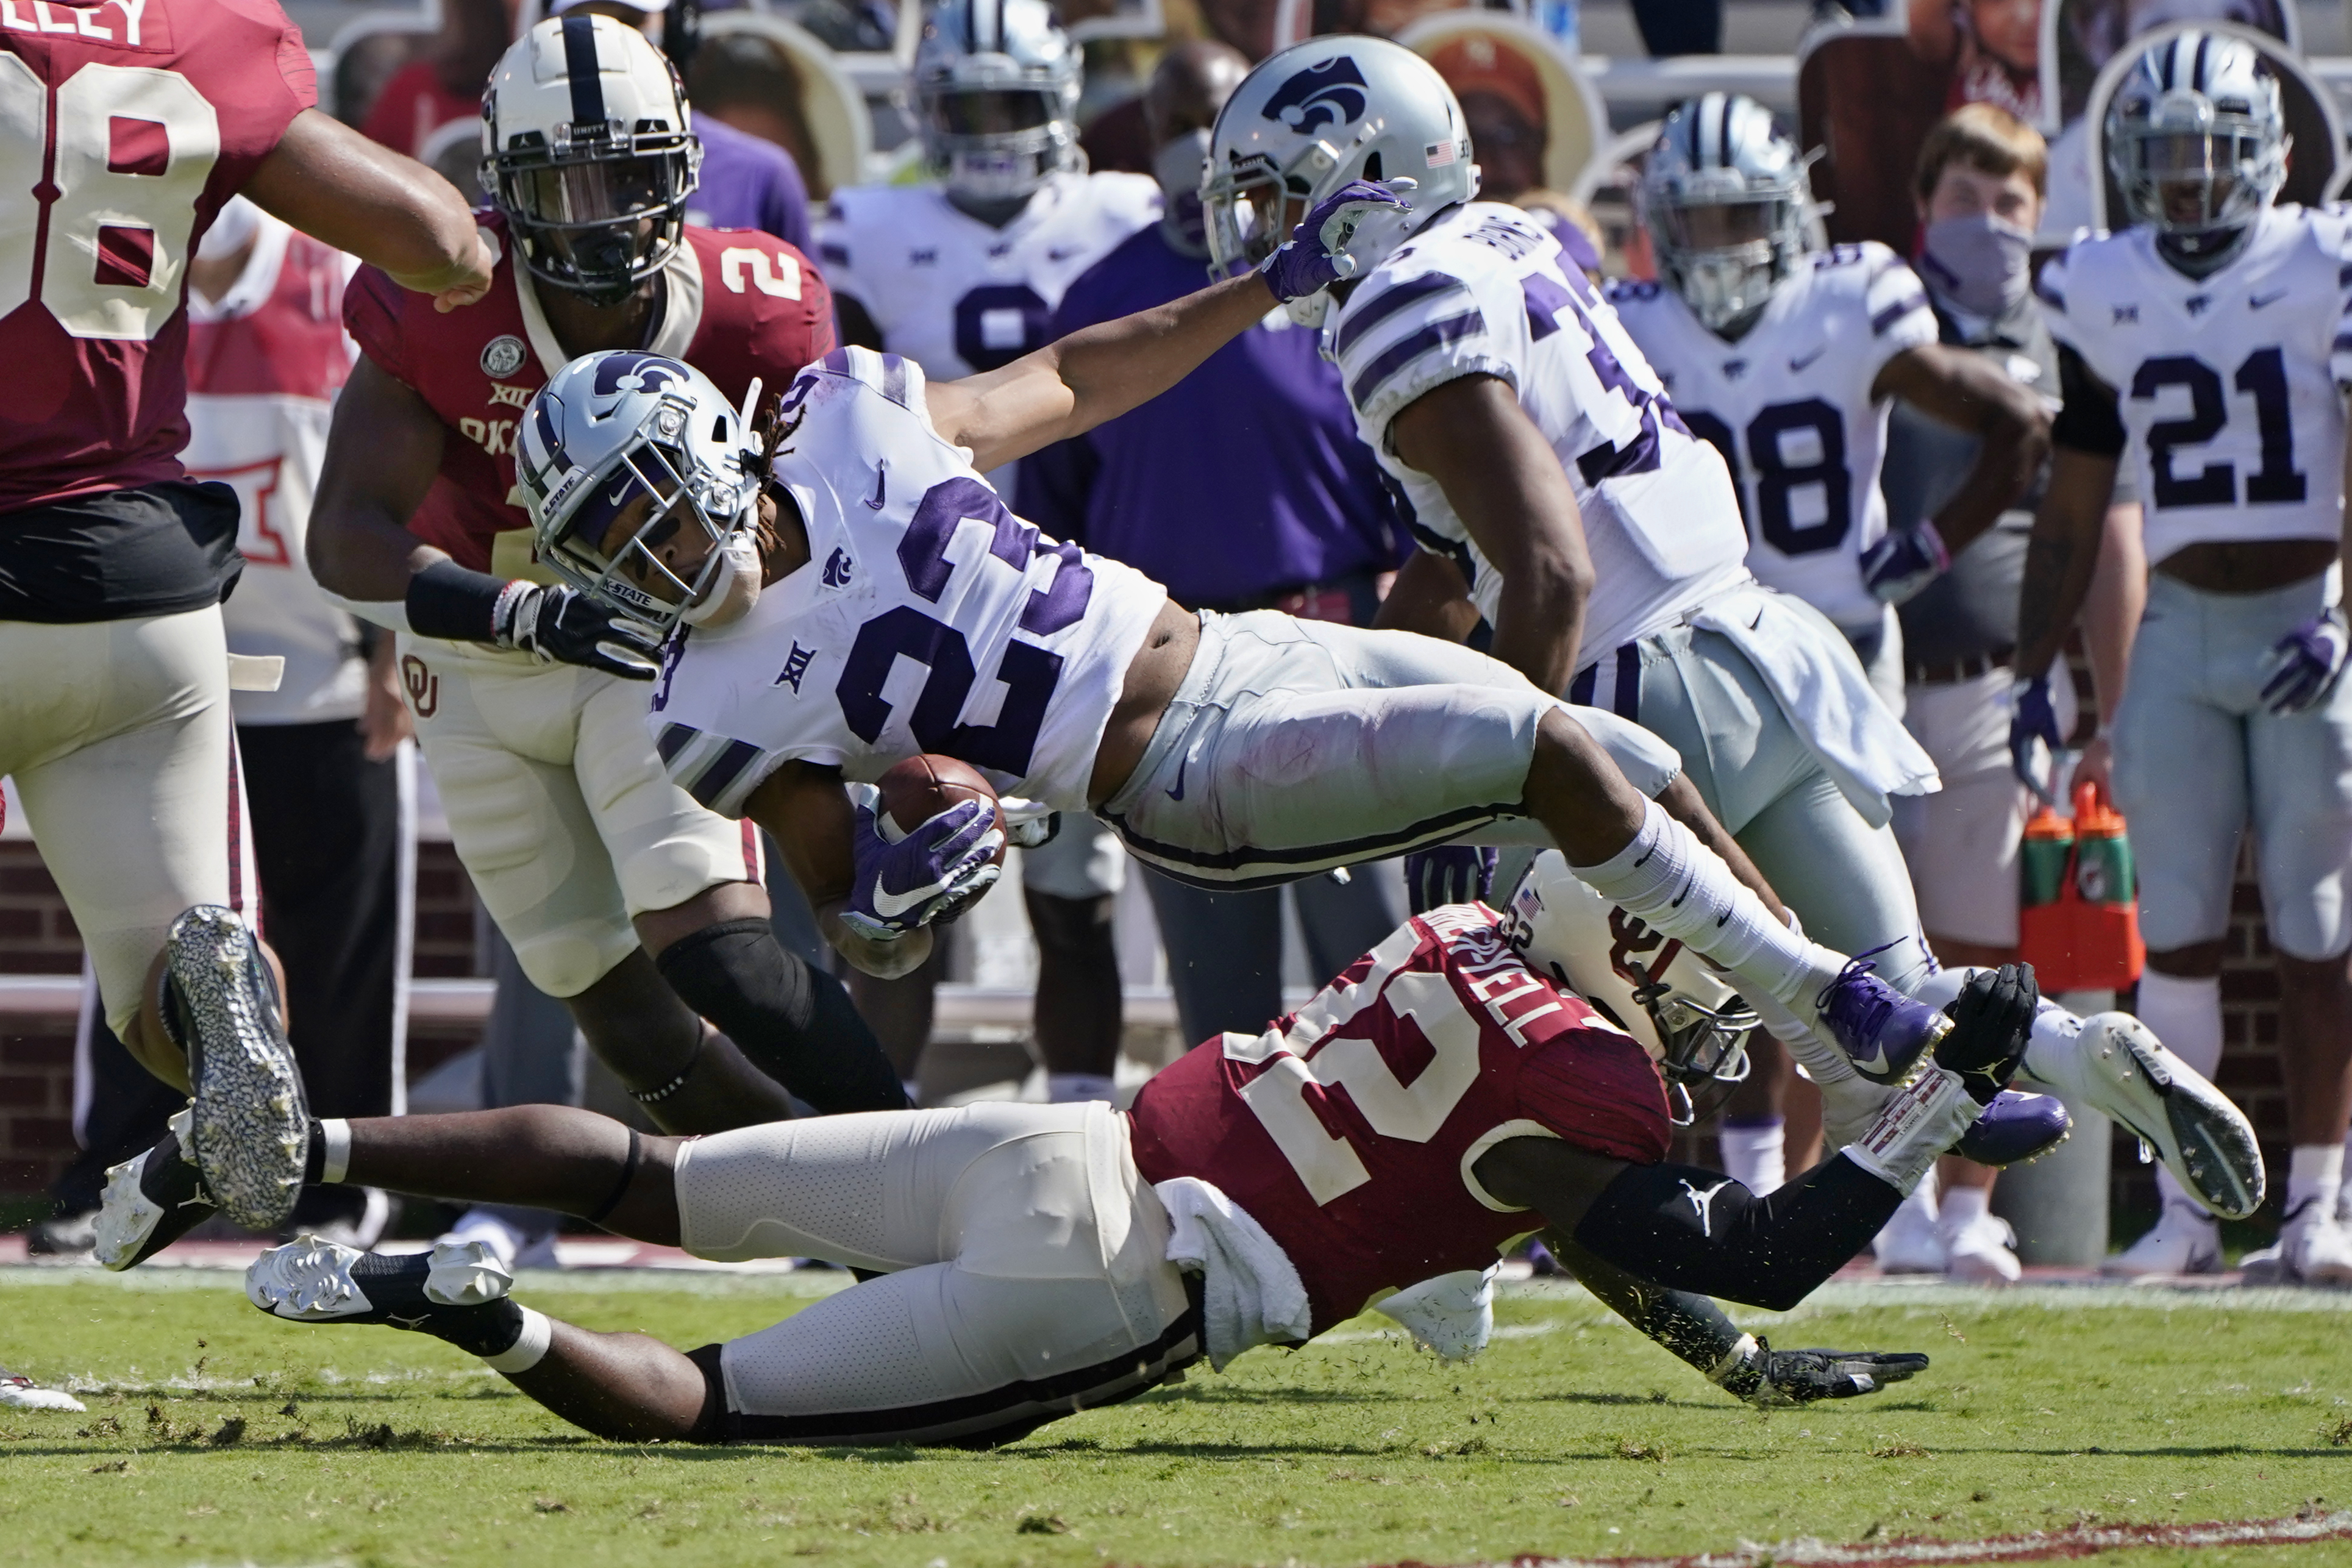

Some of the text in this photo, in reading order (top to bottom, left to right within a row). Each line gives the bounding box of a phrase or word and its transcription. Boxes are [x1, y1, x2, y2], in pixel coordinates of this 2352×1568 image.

[721, 247, 802, 301] 2
[488, 380, 534, 410] XII
[2132, 344, 2306, 511] 21
[543, 476, 574, 516] K-STATE
[602, 579, 652, 606] K-STATE
[836, 477, 1094, 779] 23
[402, 654, 438, 718] OU
[774, 640, 817, 695] XII
